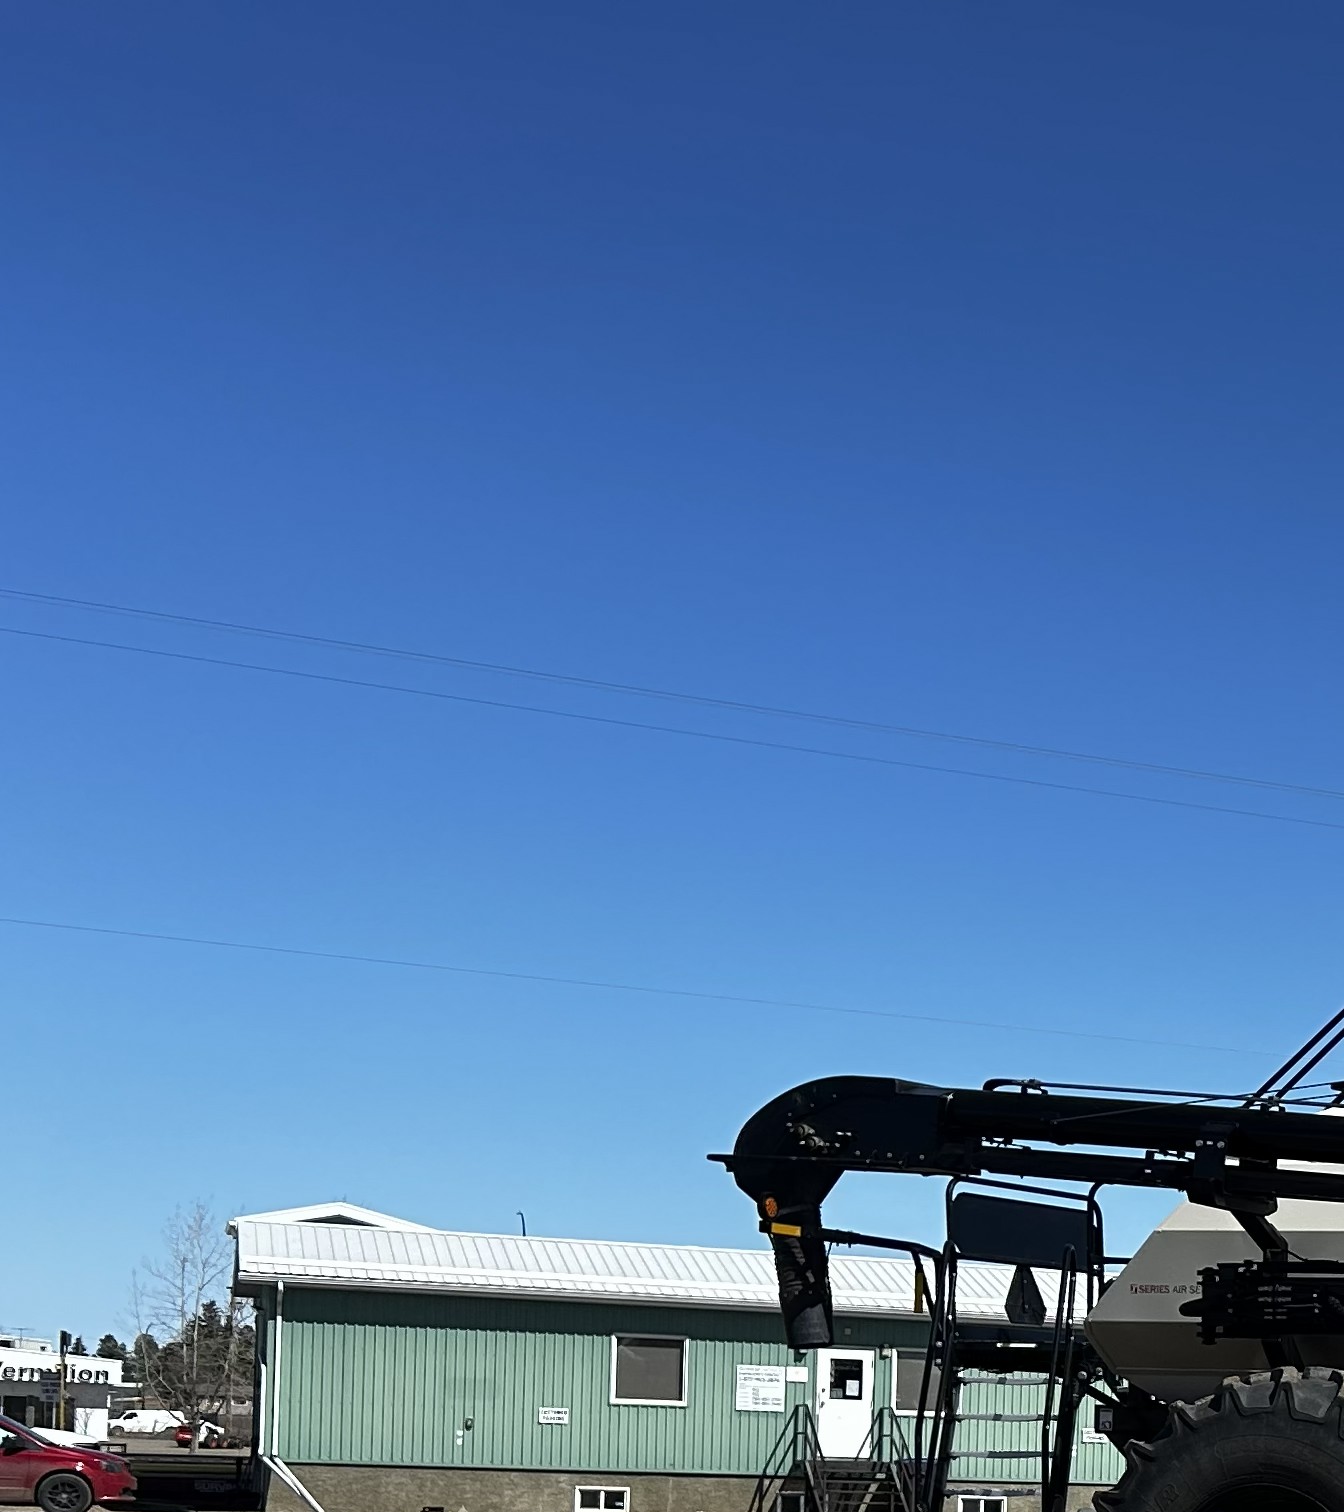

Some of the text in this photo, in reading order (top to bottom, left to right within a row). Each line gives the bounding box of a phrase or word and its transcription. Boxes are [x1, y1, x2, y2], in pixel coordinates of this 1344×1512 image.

[1138, 1284, 1170, 1294] SERIES
[1173, 1285, 1188, 1294] AIR
[0, 1361, 109, 1380] ermlion
